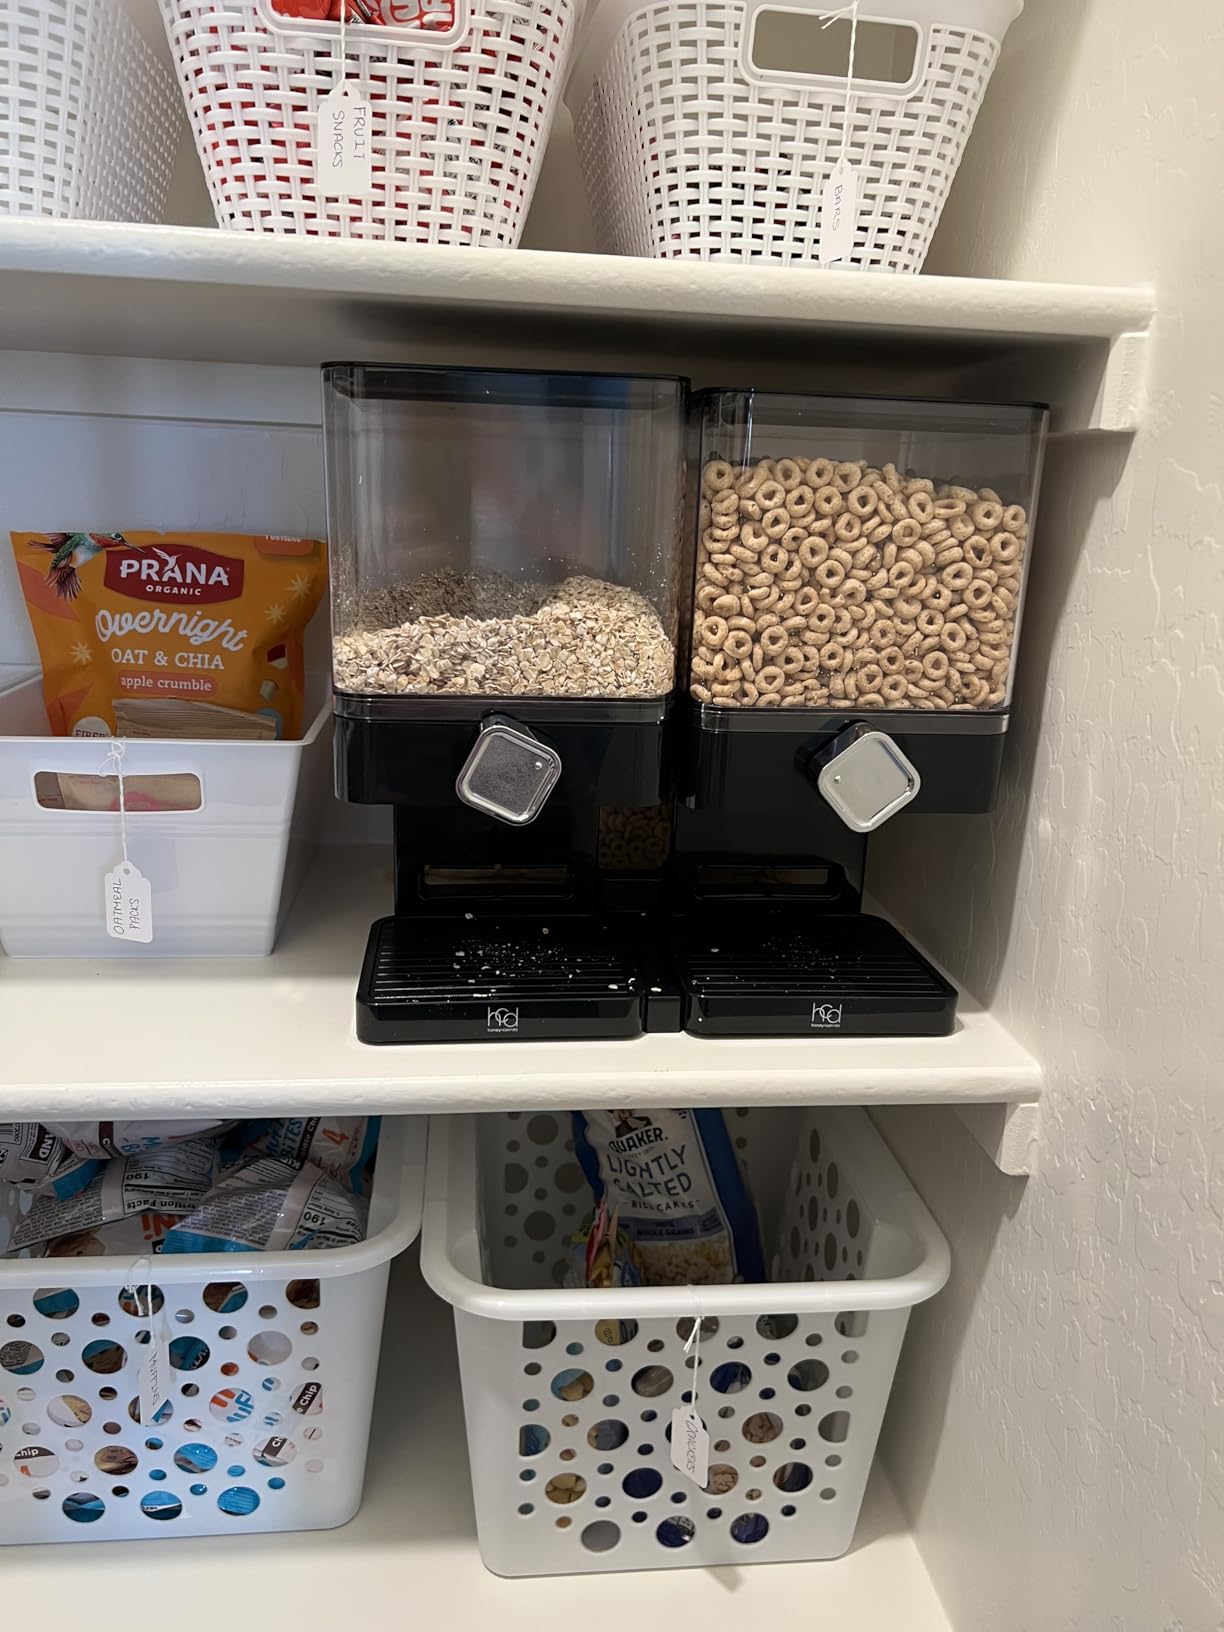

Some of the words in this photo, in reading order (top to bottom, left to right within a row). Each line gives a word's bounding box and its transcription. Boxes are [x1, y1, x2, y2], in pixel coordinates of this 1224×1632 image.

[332, 110, 345, 168] SNACKS
[353, 106, 367, 160] FRUIT
[832, 184, 843, 231] BARS
[119, 558, 230, 587] PRANA
[145, 584, 202, 597] ORGANIC
[95, 608, 249, 652] Overnight
[111, 648, 148, 665] OAT
[154, 651, 168, 666] &
[174, 651, 225, 670] CHIA
[120, 675, 153, 690] apple
[157, 676, 212, 692] crumble
[112, 878, 125, 935] OATMEAL
[129, 898, 140, 930] PACKS
[608, 1127, 664, 1154] QUAKER
[607, 1144, 687, 1180] LIGHTLY
[612, 1171, 692, 1198] SALTED
[303, 1211, 326, 1226] 190
[299, 1385, 318, 1406] Chip
